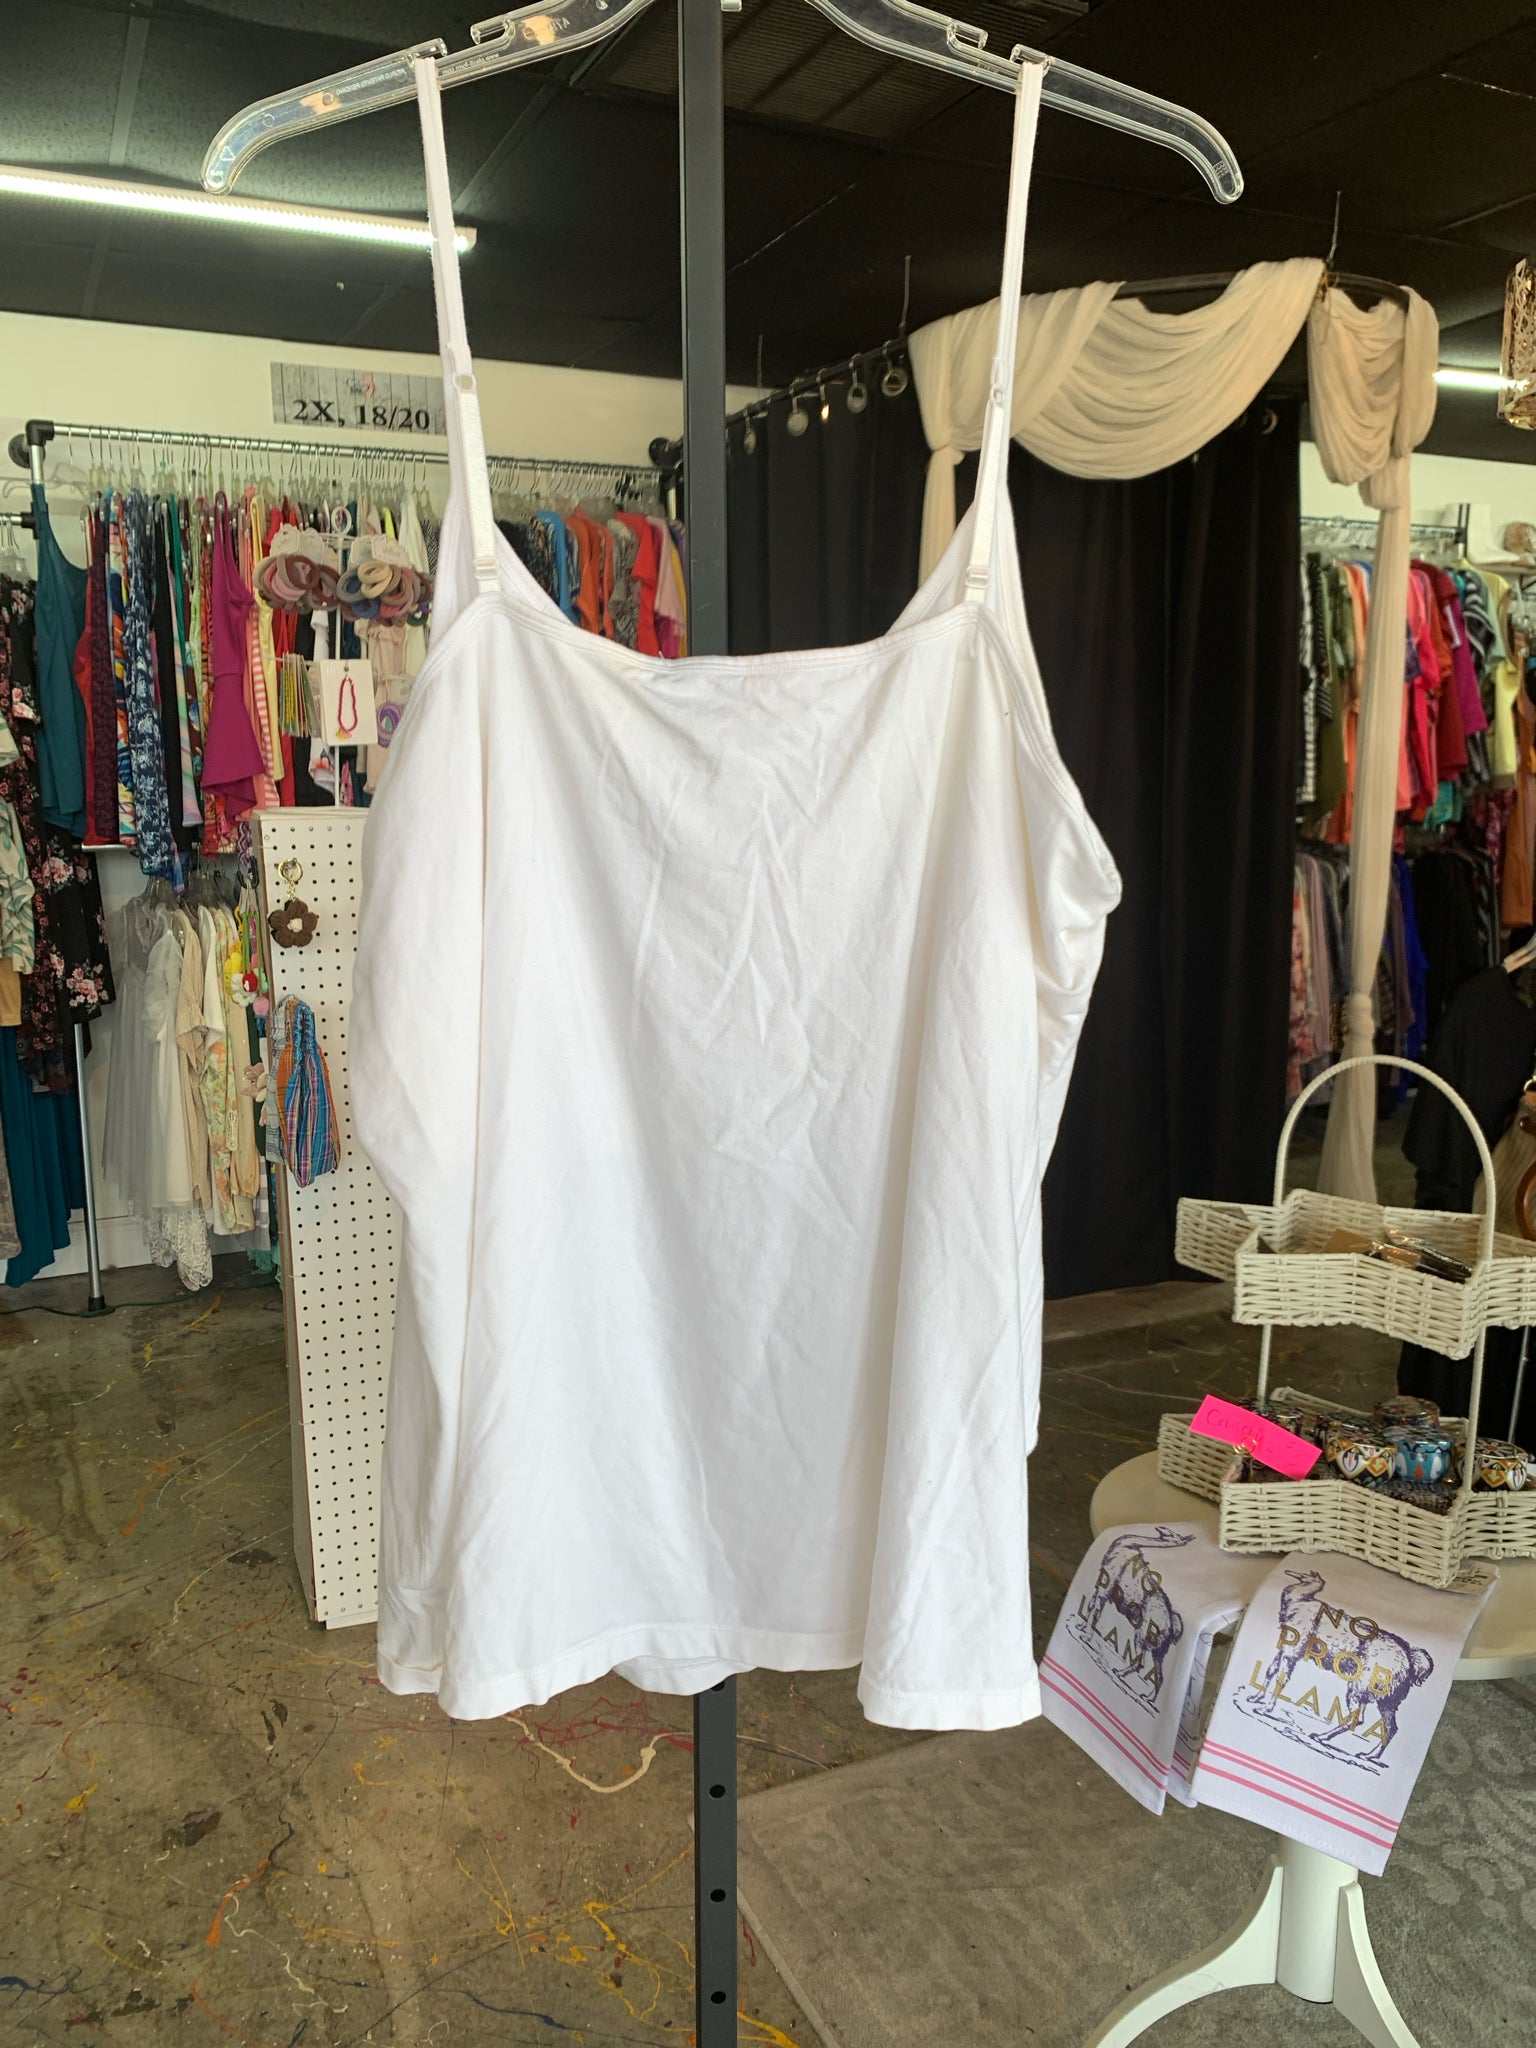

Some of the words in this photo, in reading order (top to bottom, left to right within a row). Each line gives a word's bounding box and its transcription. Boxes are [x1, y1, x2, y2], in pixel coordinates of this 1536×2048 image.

[292, 400, 345, 427] 2X,
[354, 404, 430, 430] 18/20
[1095, 1567, 1160, 1647] PROB
[1117, 1554, 1162, 1595] NO
[1077, 1594, 1159, 1693] LLAMA
[1315, 1602, 1379, 1640] NO
[1276, 1624, 1393, 1696] PROB
[1249, 1660, 1388, 1747] LLAMA
